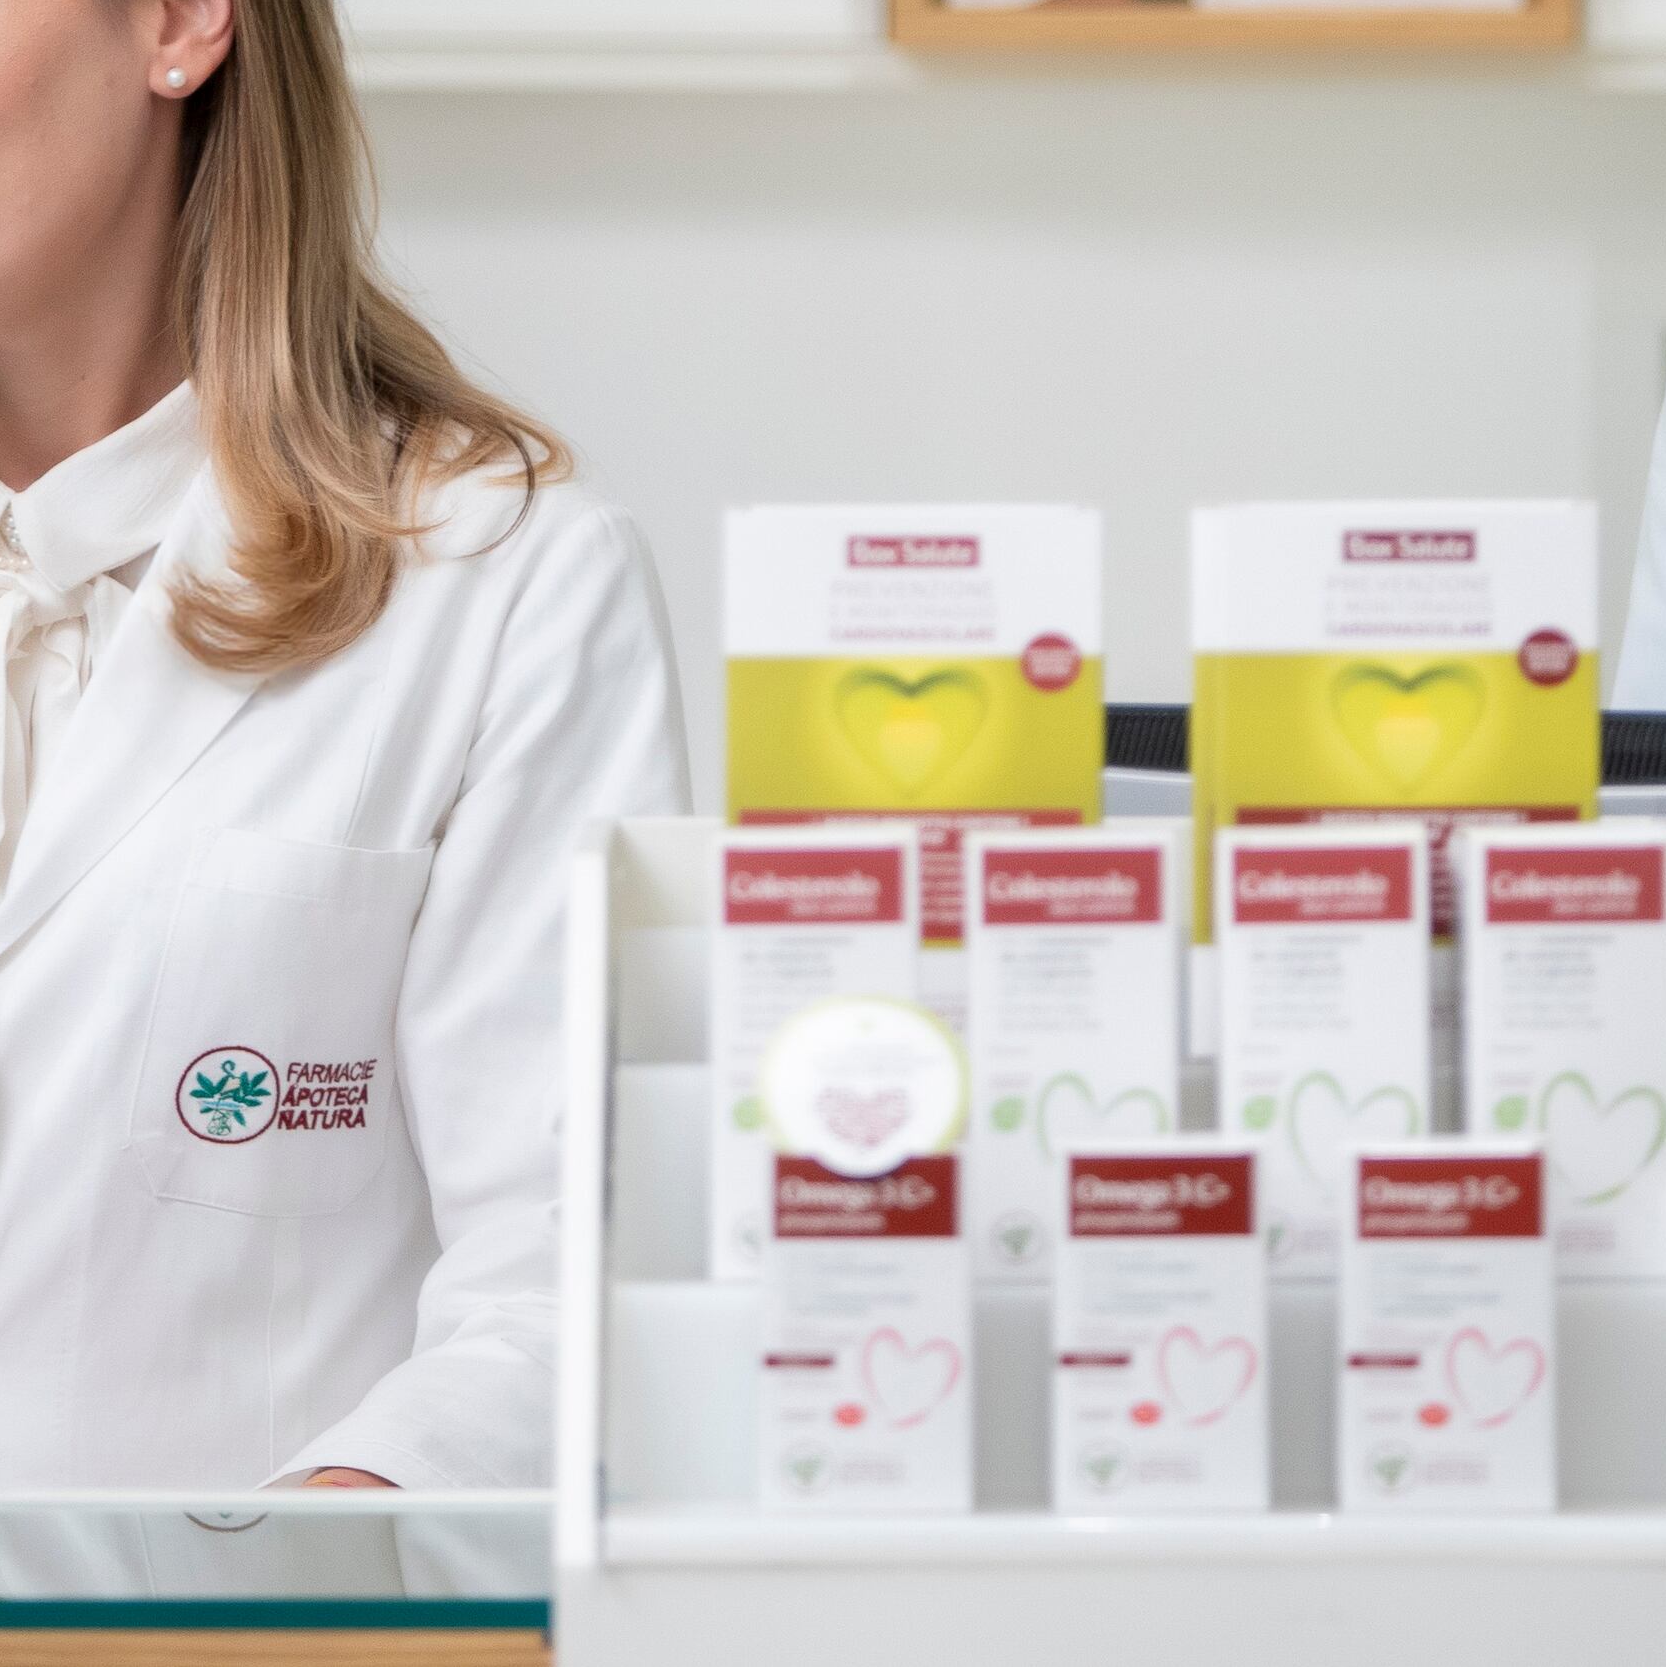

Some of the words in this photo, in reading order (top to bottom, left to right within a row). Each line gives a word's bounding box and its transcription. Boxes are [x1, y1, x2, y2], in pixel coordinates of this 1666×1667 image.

[286, 1059, 378, 1083] FARMACIE
[282, 1083, 369, 1107] APOTECA
[277, 1108, 366, 1130] NATURA
